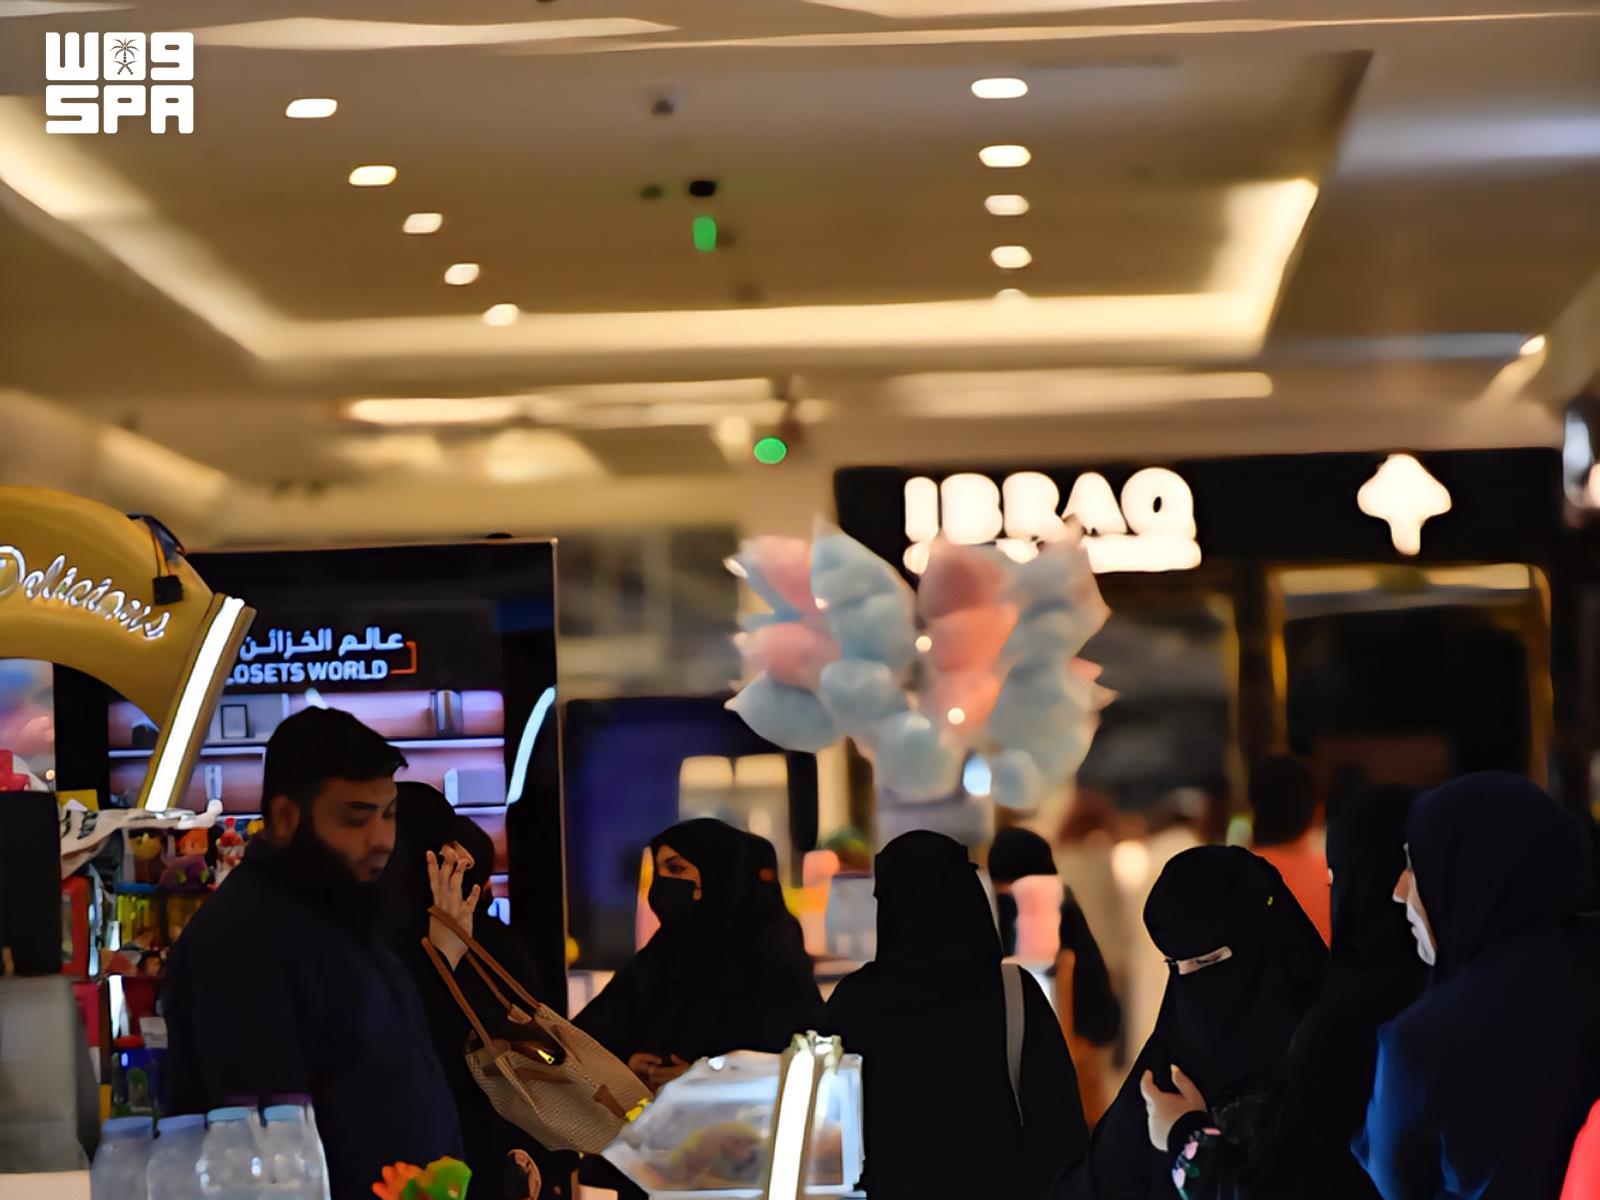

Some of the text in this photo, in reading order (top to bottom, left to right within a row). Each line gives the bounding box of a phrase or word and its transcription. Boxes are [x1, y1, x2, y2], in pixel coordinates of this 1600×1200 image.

[239, 627, 404, 661] عالم الخزائن
[226, 660, 389, 686] OSETS WORLD
